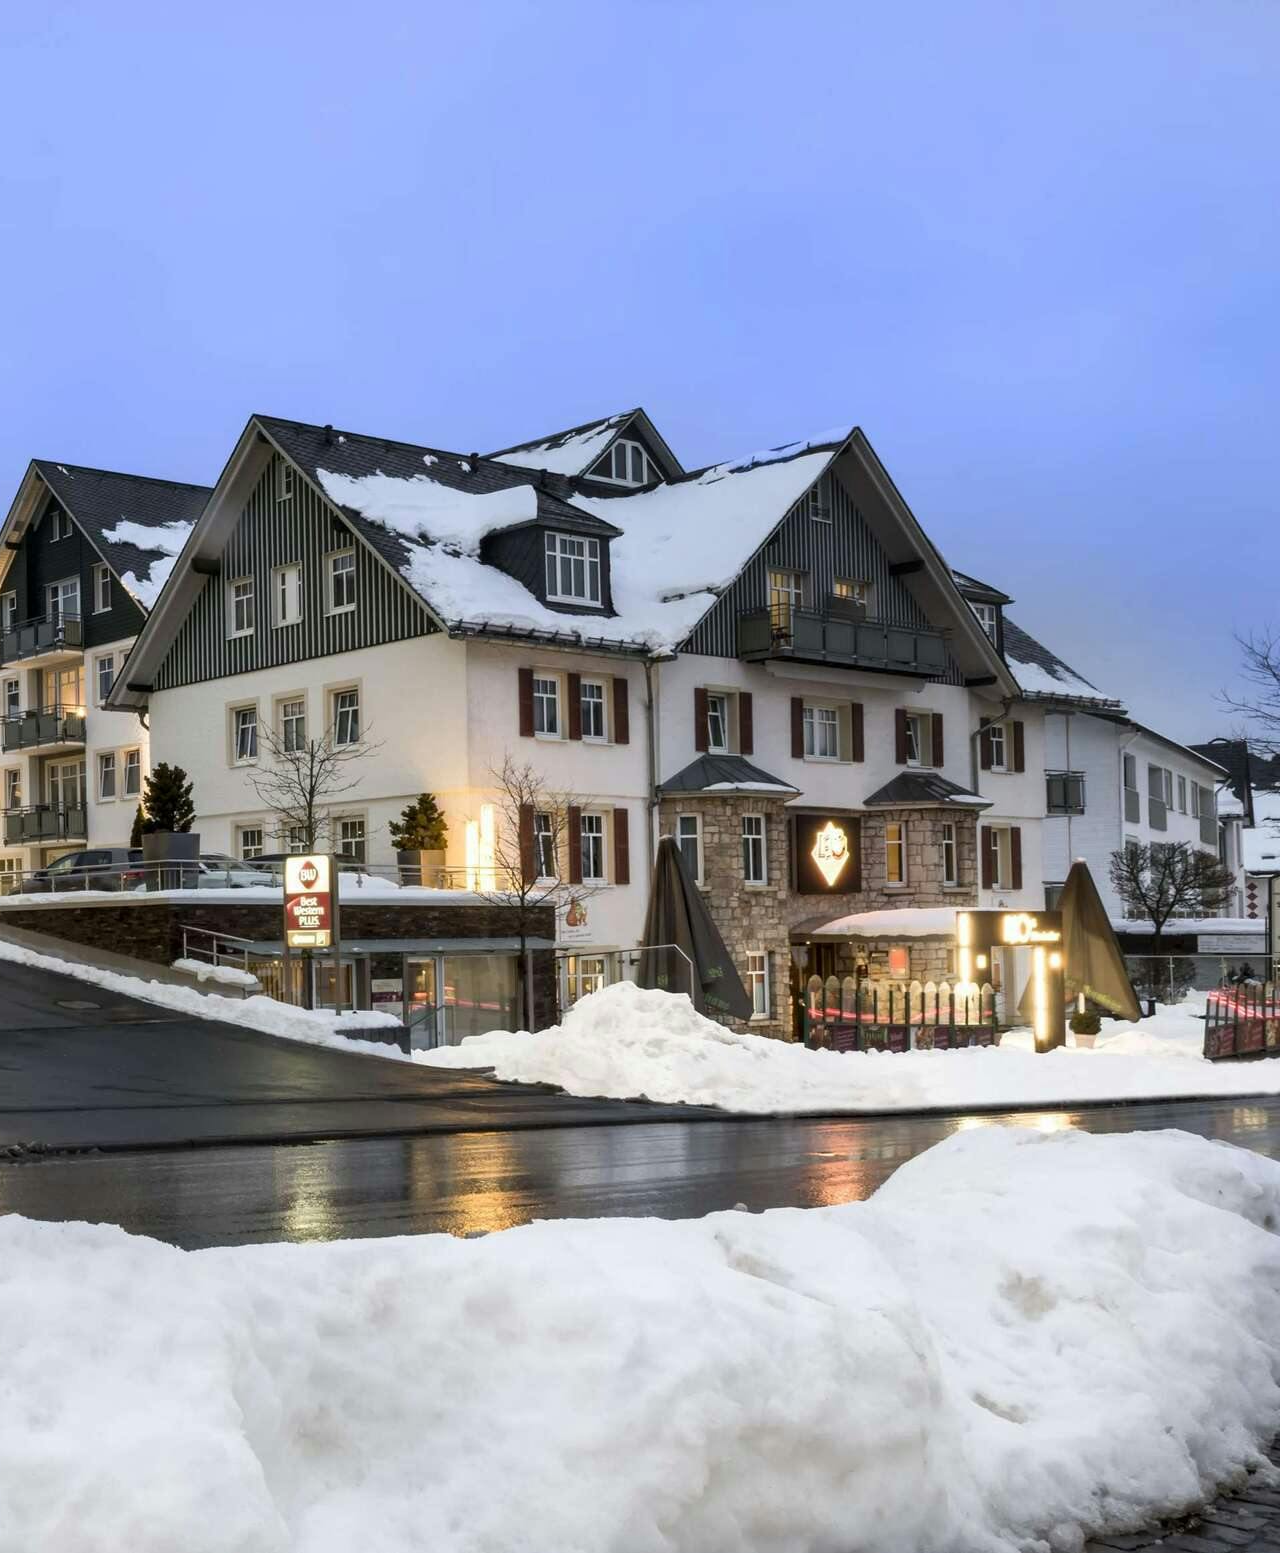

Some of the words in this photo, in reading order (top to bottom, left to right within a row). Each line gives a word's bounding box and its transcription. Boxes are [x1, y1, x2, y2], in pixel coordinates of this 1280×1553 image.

[300, 869, 317, 881] BW
[300, 896, 318, 906] Best
[293, 906, 324, 916] Western
